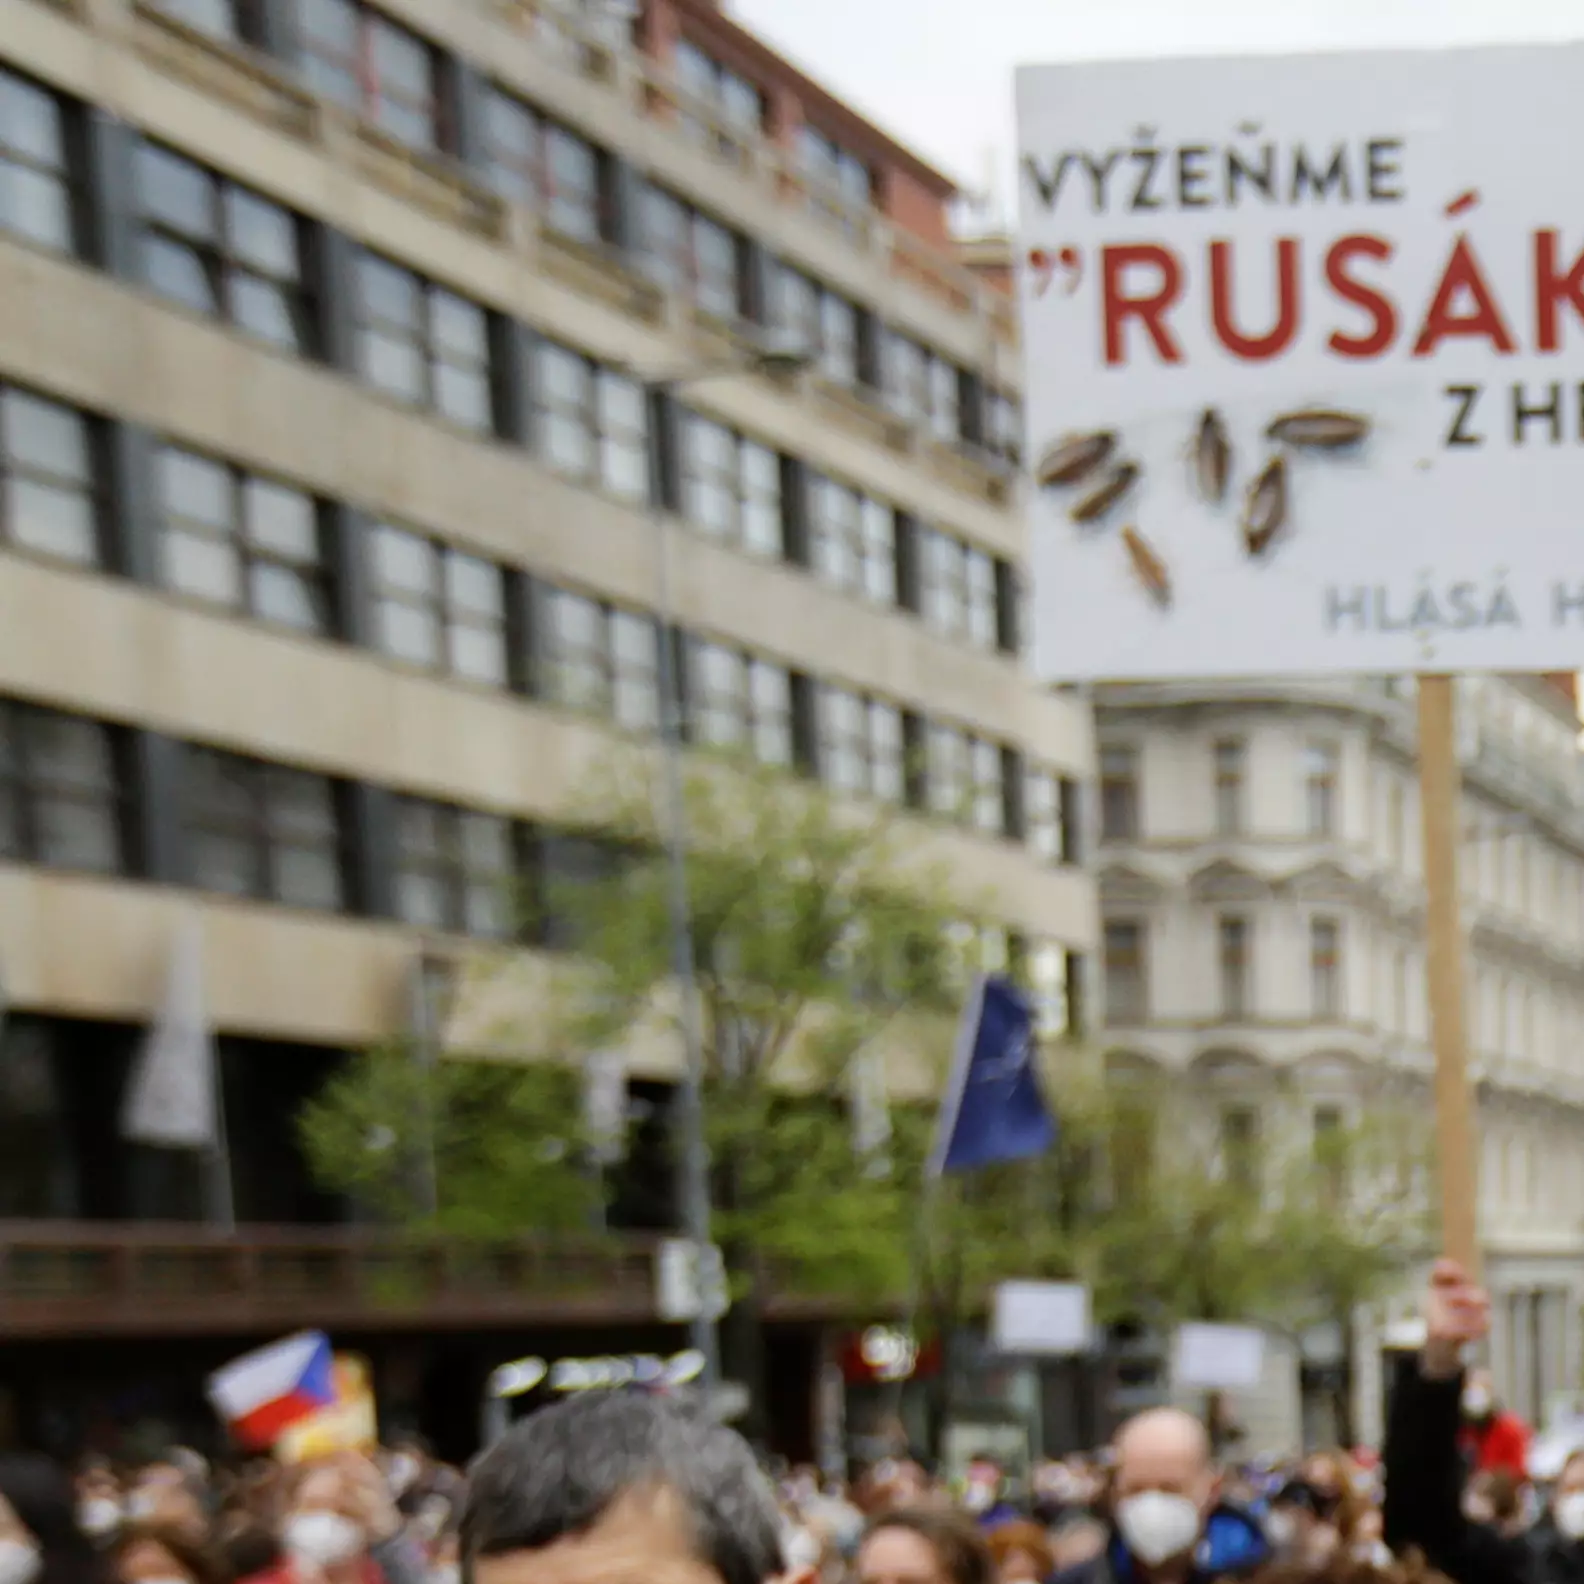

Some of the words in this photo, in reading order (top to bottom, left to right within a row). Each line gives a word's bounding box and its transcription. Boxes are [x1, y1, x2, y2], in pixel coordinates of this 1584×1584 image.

[1022, 122, 1407, 214] VYŽEŇME
[1443, 384, 1484, 448] Z
[1322, 564, 1522, 633] HLÁSÁ
